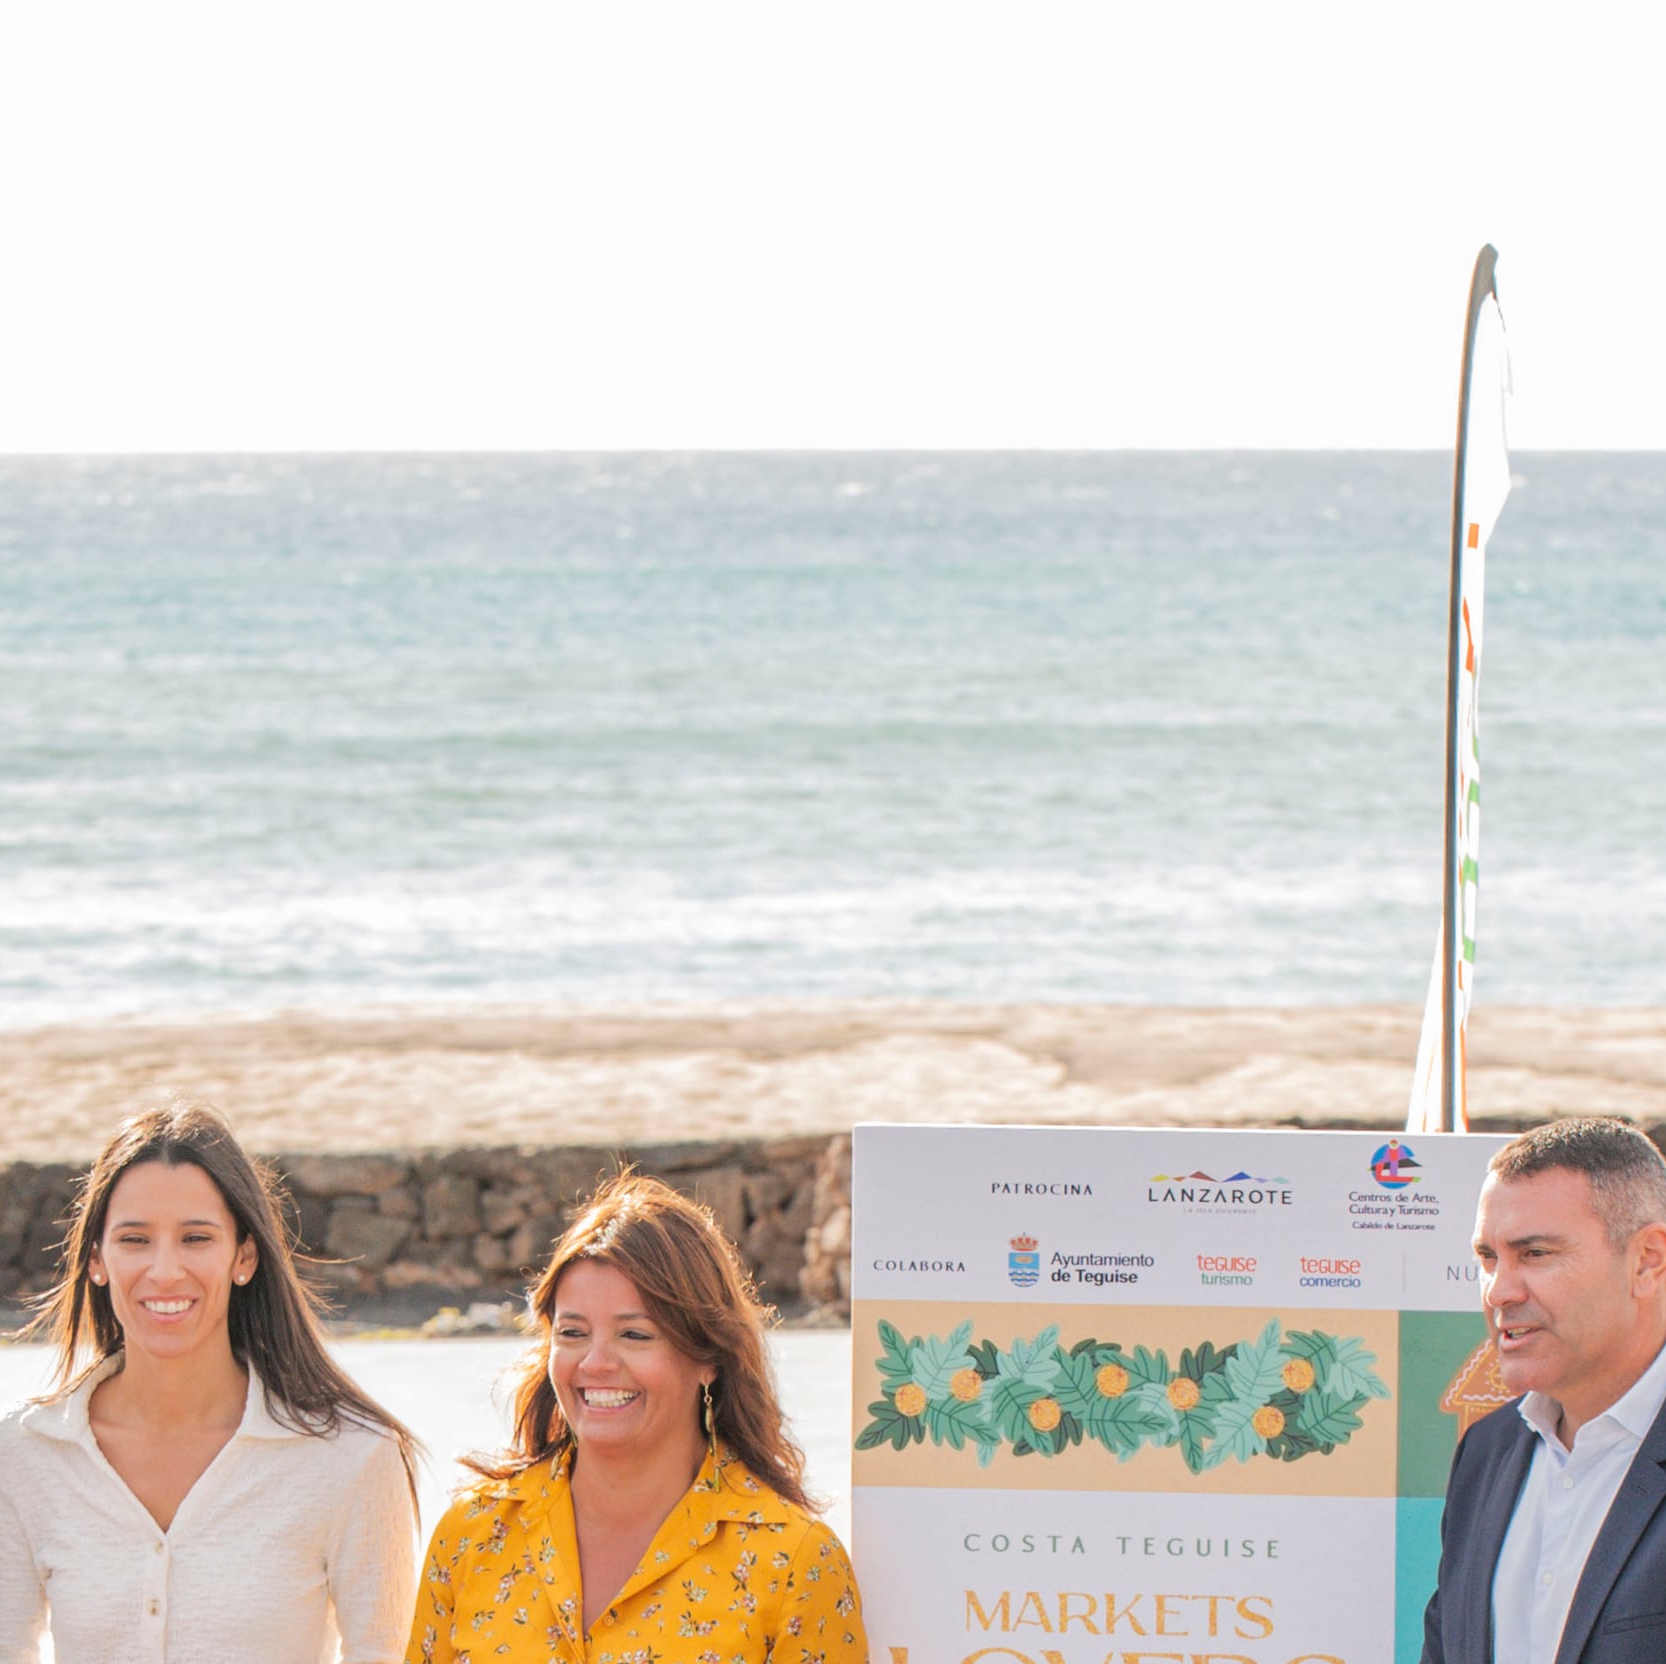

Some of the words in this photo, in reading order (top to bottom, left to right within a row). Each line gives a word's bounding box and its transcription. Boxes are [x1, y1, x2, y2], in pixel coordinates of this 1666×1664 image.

[991, 1182, 1093, 1196] PATROCINA
[1148, 1187, 1293, 1205] LANZAROTE
[1348, 1191, 1392, 1203] Centros
[1394, 1192, 1409, 1203] de
[1348, 1203, 1388, 1215] Cultura
[1389, 1207, 1396, 1218] y
[1397, 1204, 1440, 1216] Turismo
[1384, 1221, 1395, 1230] de
[872, 1259, 967, 1273] COLABORA
[1050, 1251, 1155, 1271] Ayuntamiento
[1050, 1268, 1072, 1283] de
[1075, 1268, 1139, 1287] Teguise
[1200, 1272, 1255, 1287] turismo
[1446, 1265, 1479, 1282] NU
[1299, 1275, 1362, 1288] comercio
[963, 1533, 1086, 1554] COSTA
[1116, 1536, 1280, 1559] TEGUISE
[963, 1589, 1276, 1641] MARKETS
